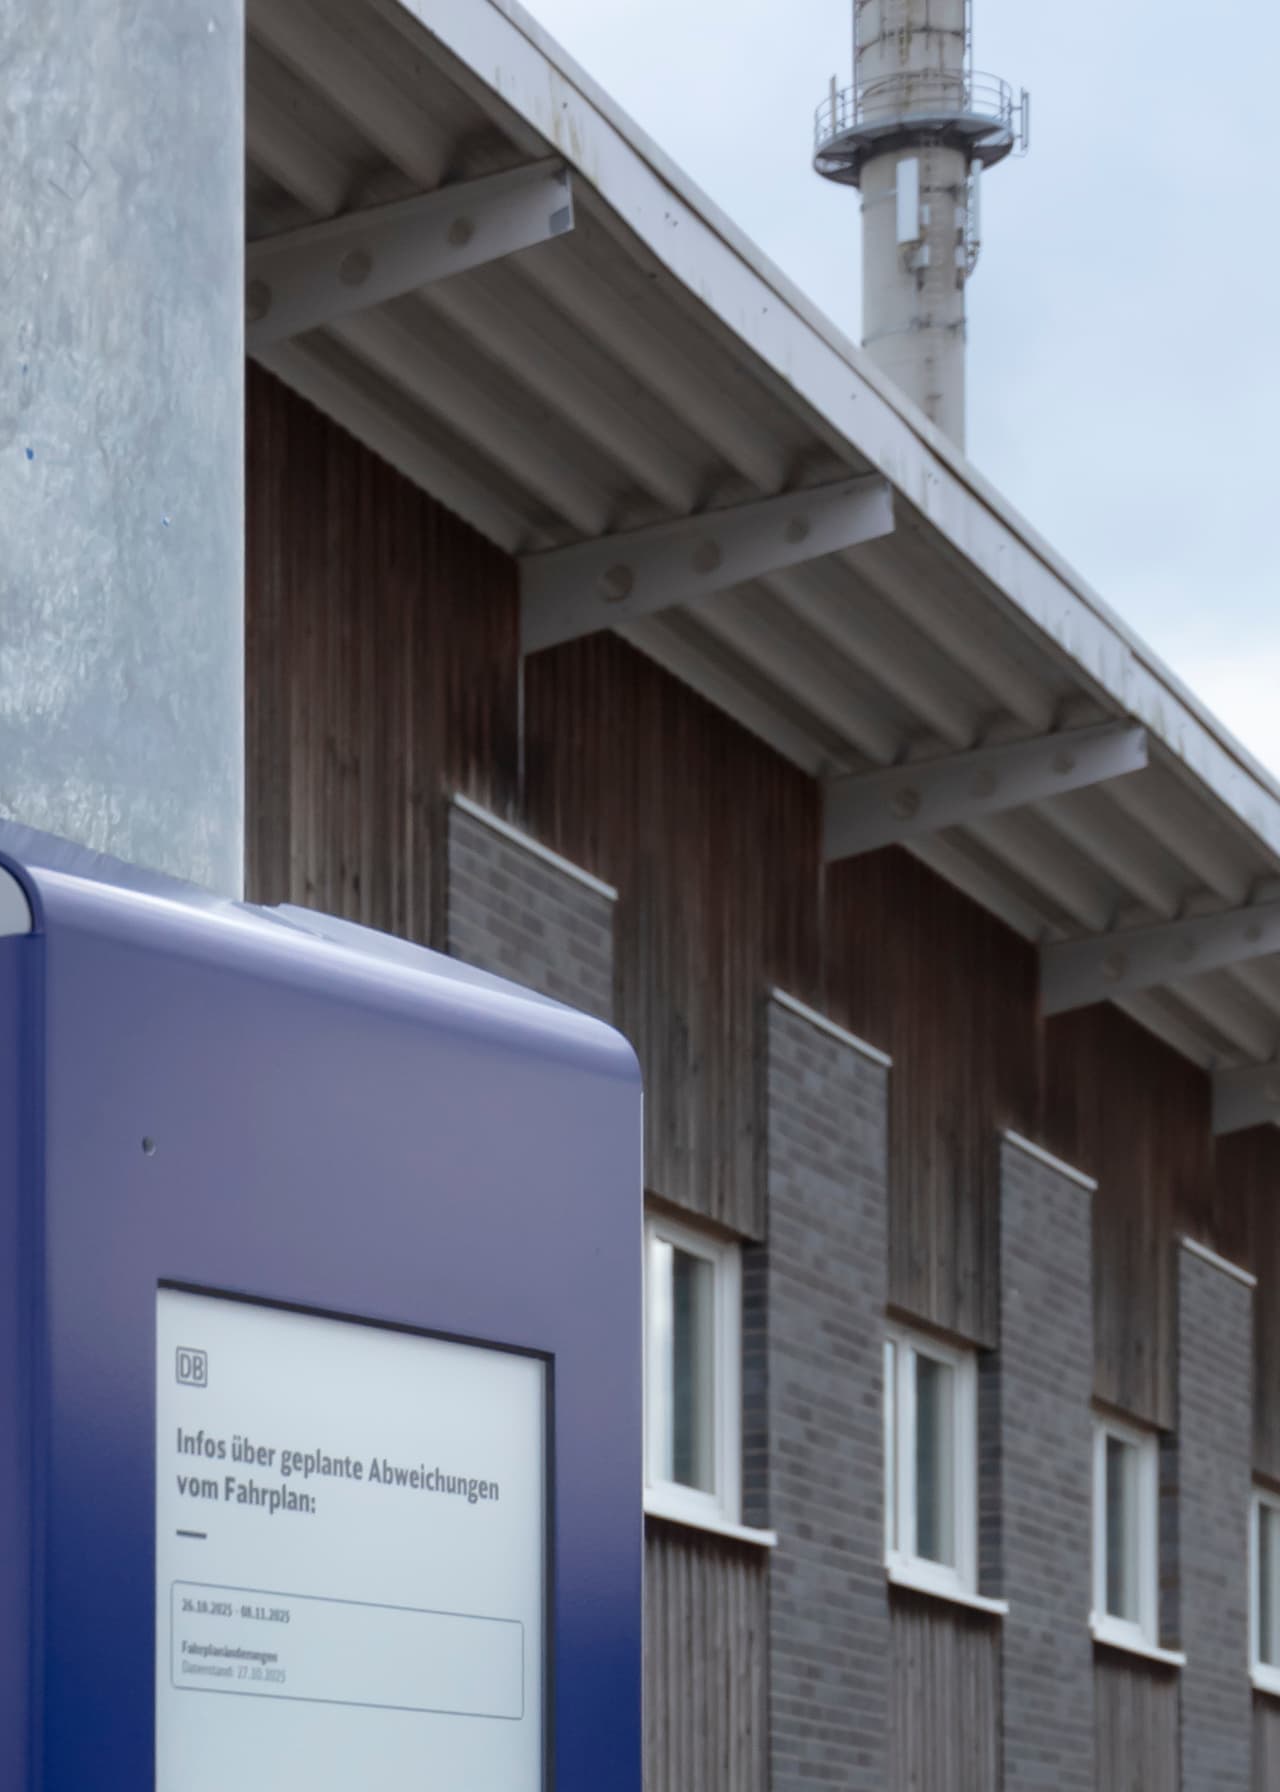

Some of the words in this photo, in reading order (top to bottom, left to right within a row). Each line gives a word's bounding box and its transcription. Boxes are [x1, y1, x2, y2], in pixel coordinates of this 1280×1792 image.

[175, 1346, 208, 1388] DB
[176, 1427, 226, 1460] Infos
[232, 1435, 276, 1468] über
[280, 1448, 363, 1480] geplante
[368, 1457, 500, 1504] Abweichungen
[177, 1474, 218, 1501] vom
[224, 1476, 316, 1516] Fahrplan:
